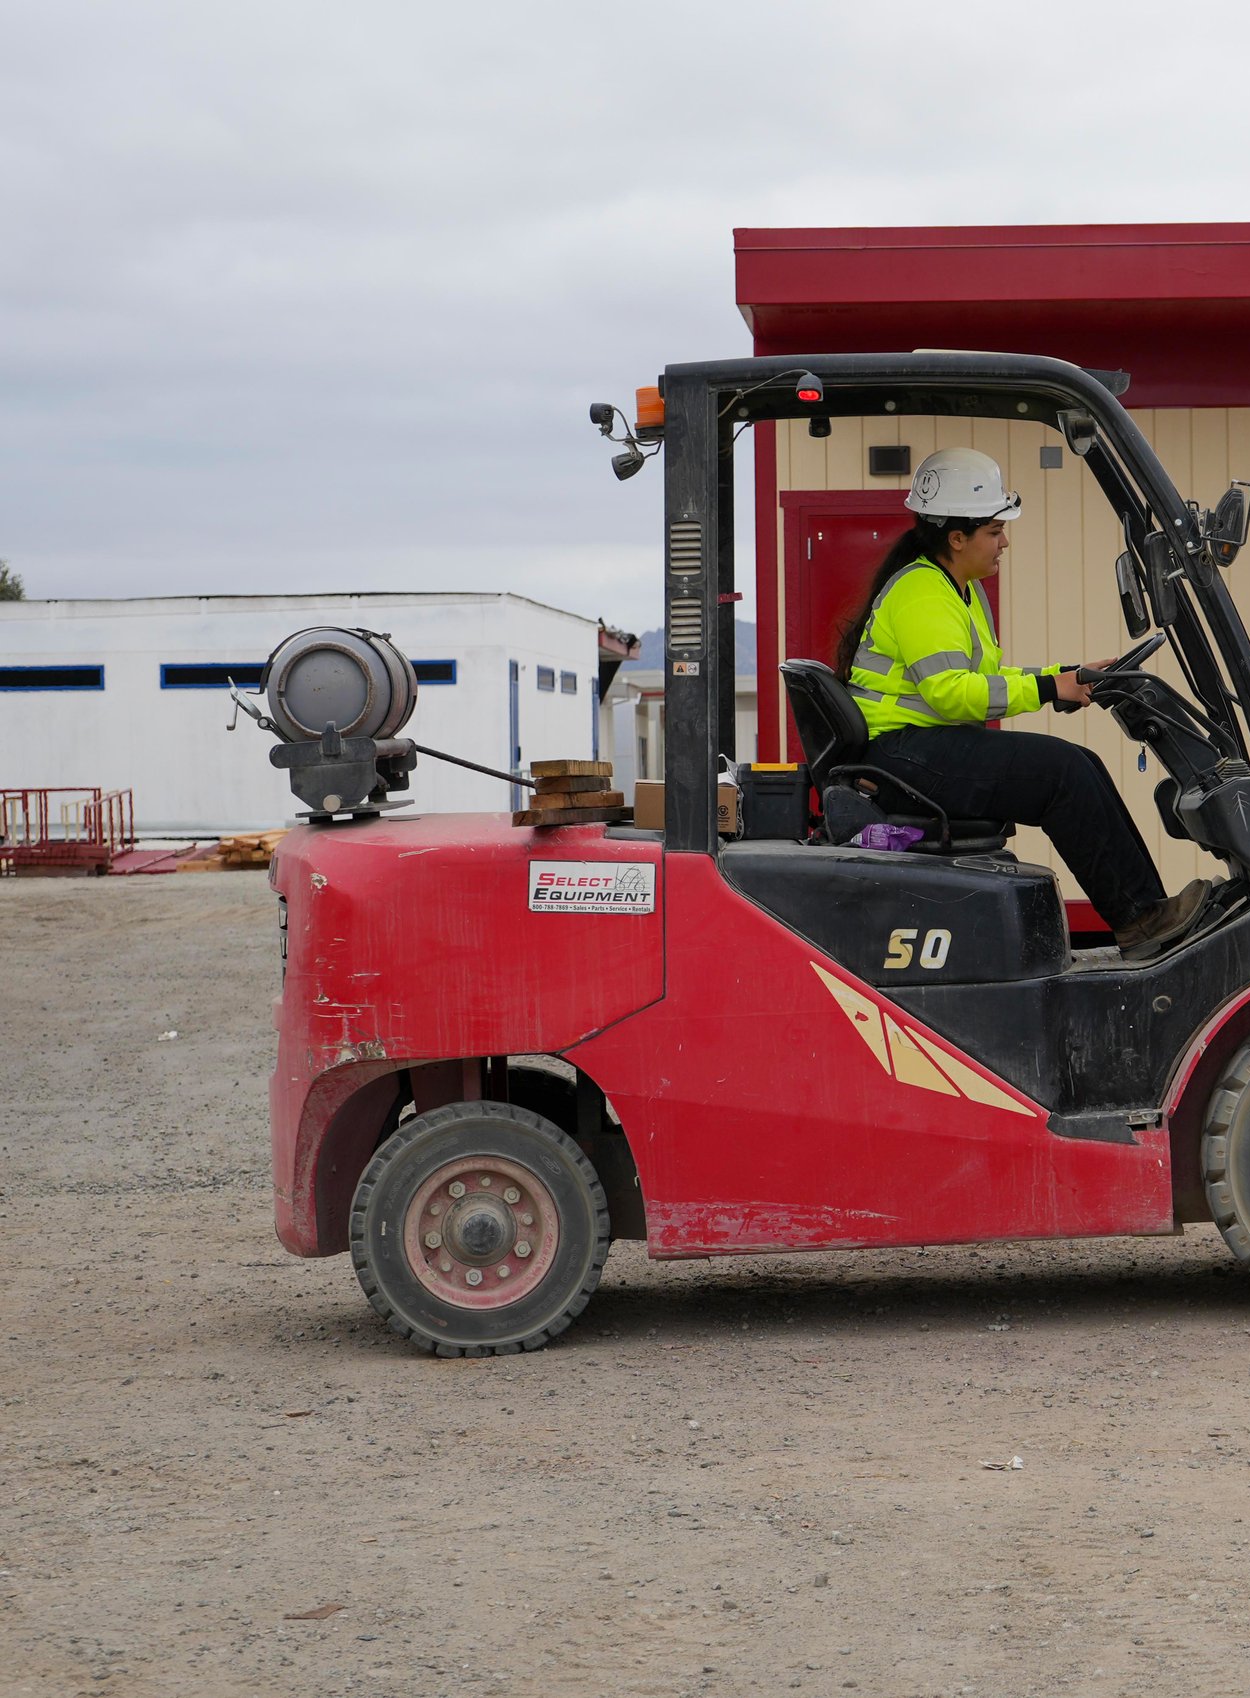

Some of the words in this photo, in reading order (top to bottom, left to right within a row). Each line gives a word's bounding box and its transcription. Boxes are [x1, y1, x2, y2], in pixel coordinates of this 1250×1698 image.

[537, 873, 614, 887] SELECT
[533, 888, 651, 902] EQUIPMENT
[883, 928, 952, 970] 50
